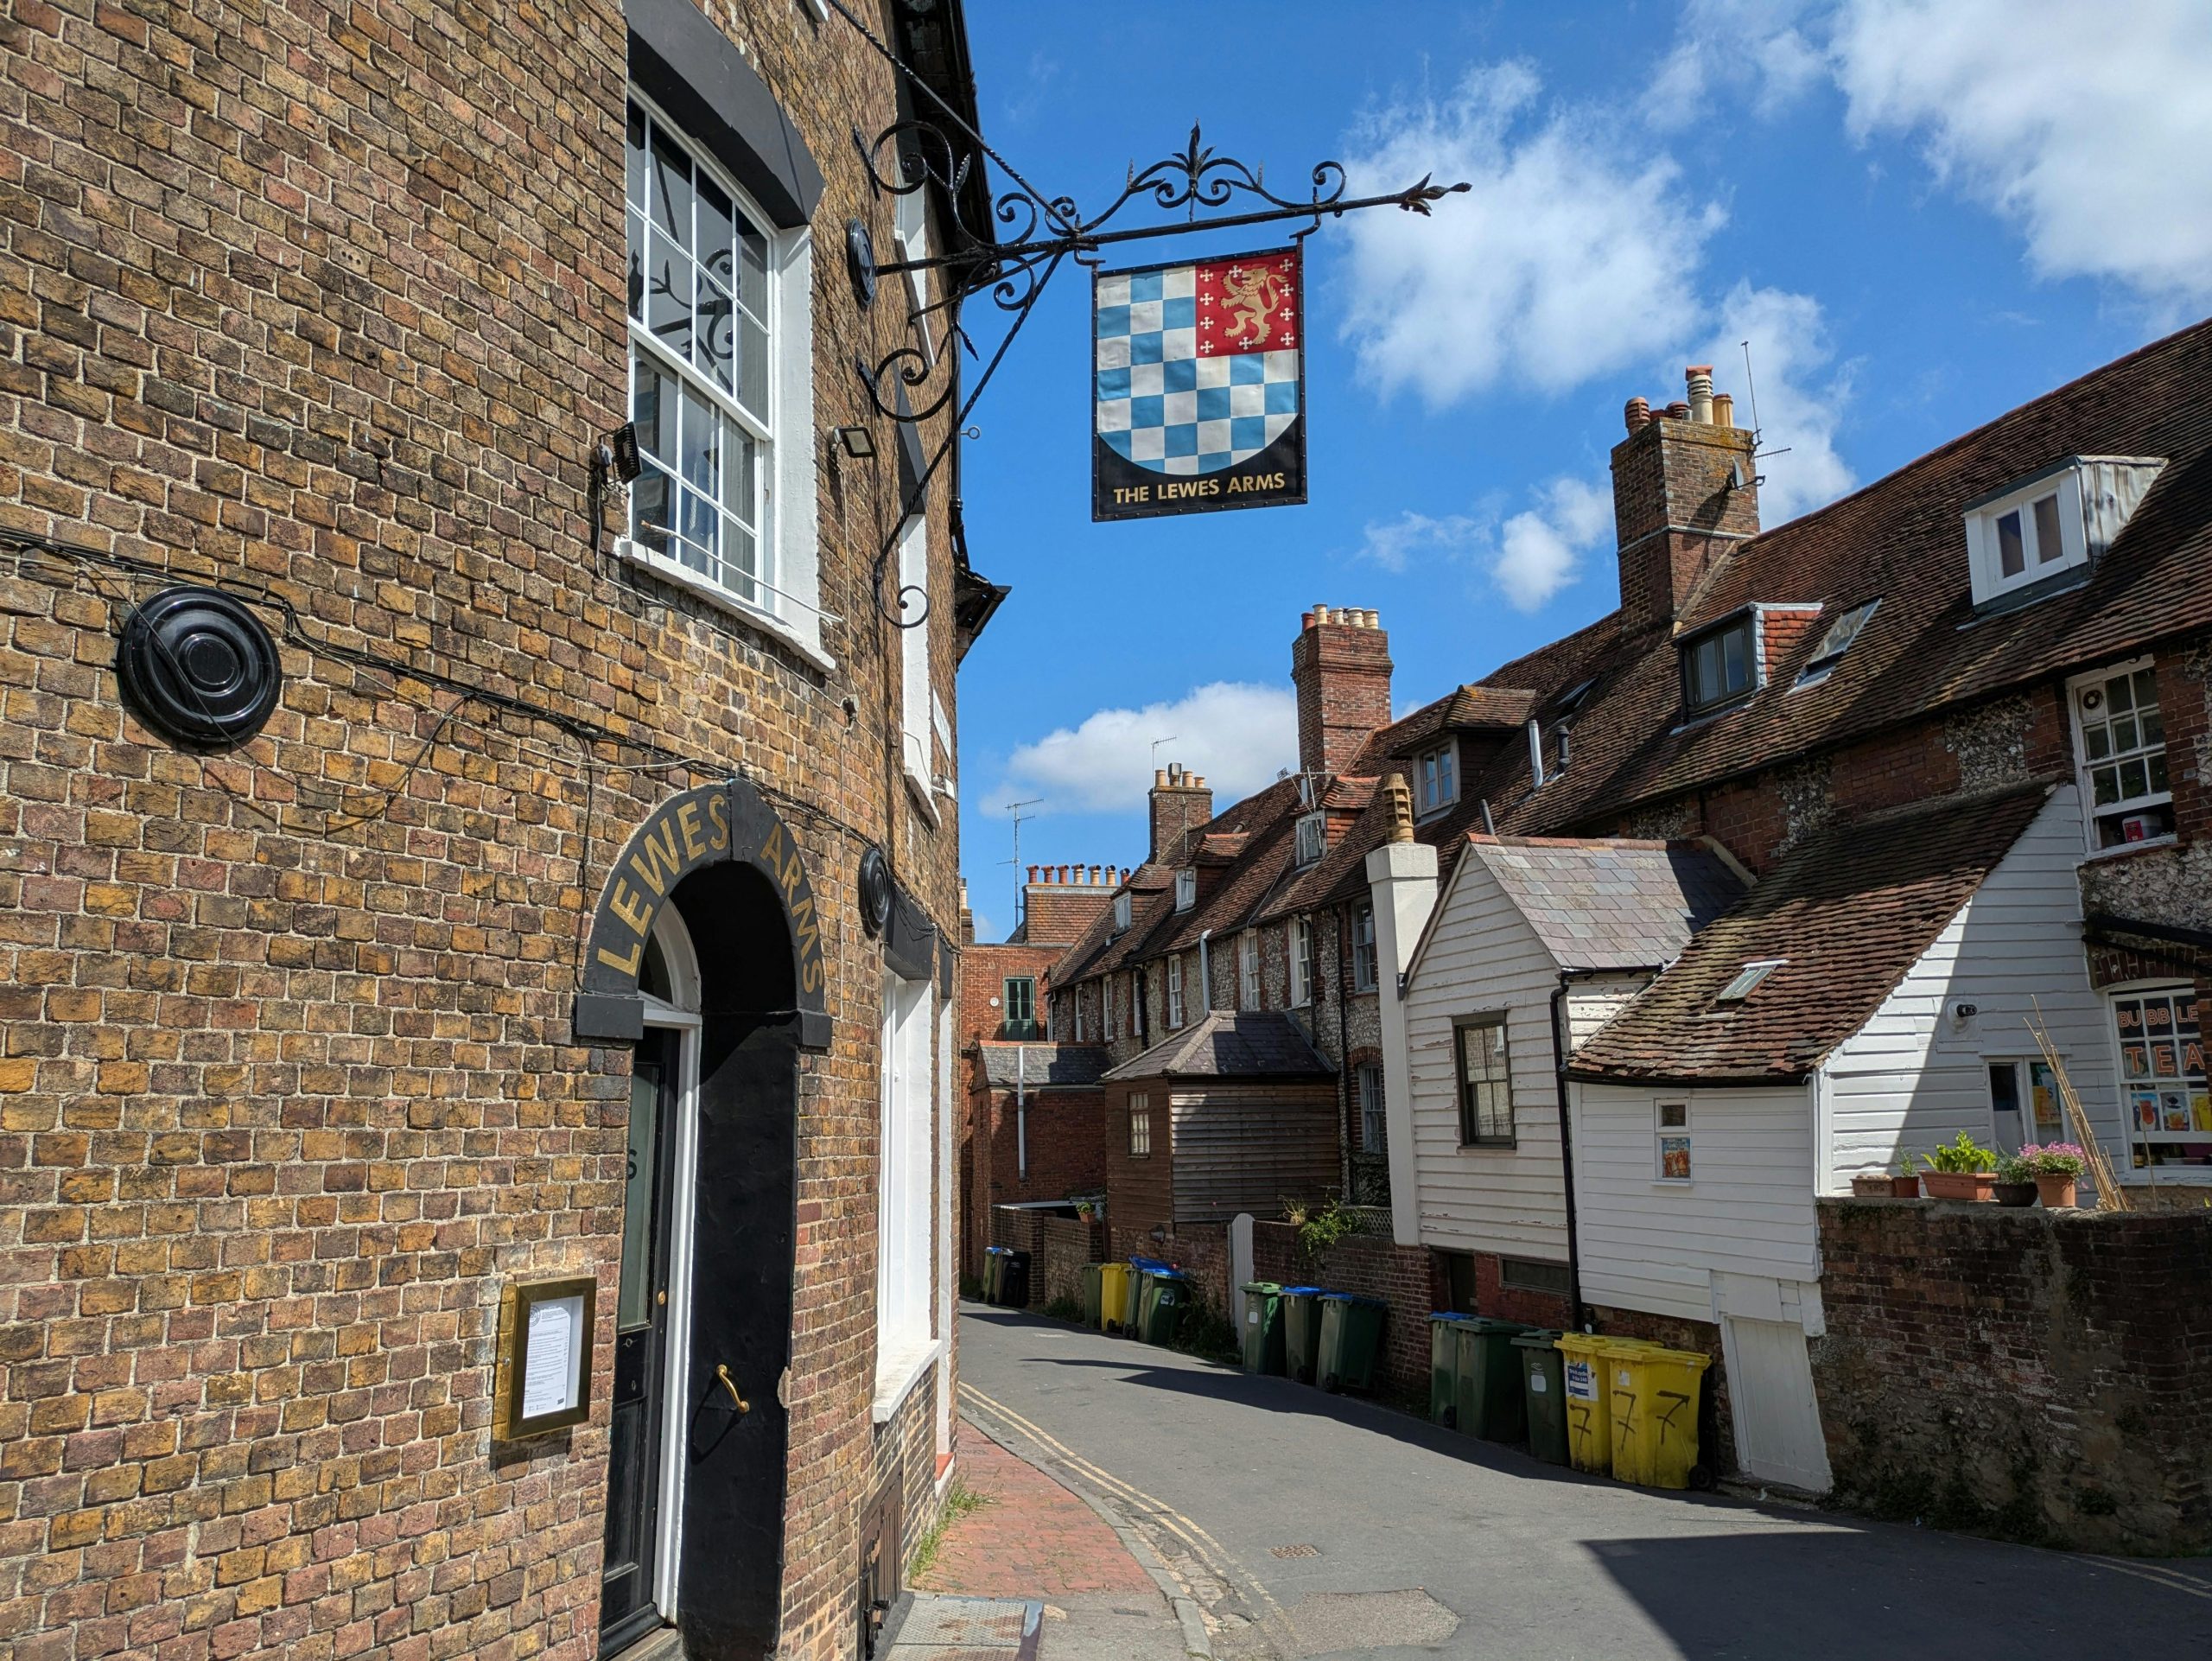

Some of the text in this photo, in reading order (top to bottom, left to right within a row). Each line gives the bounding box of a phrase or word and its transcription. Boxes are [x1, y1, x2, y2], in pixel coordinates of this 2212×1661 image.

[1114, 473, 1286, 504] THE LEWES ARMS
[597, 794, 823, 994] LEWES ARMS
[2118, 1005, 2199, 1028] BUBBLE
[2124, 1043, 2206, 1073] TEA
[1569, 1403, 1592, 1449] 7
[1612, 1390, 1637, 1452] 7
[1656, 1390, 1691, 1445] 7
